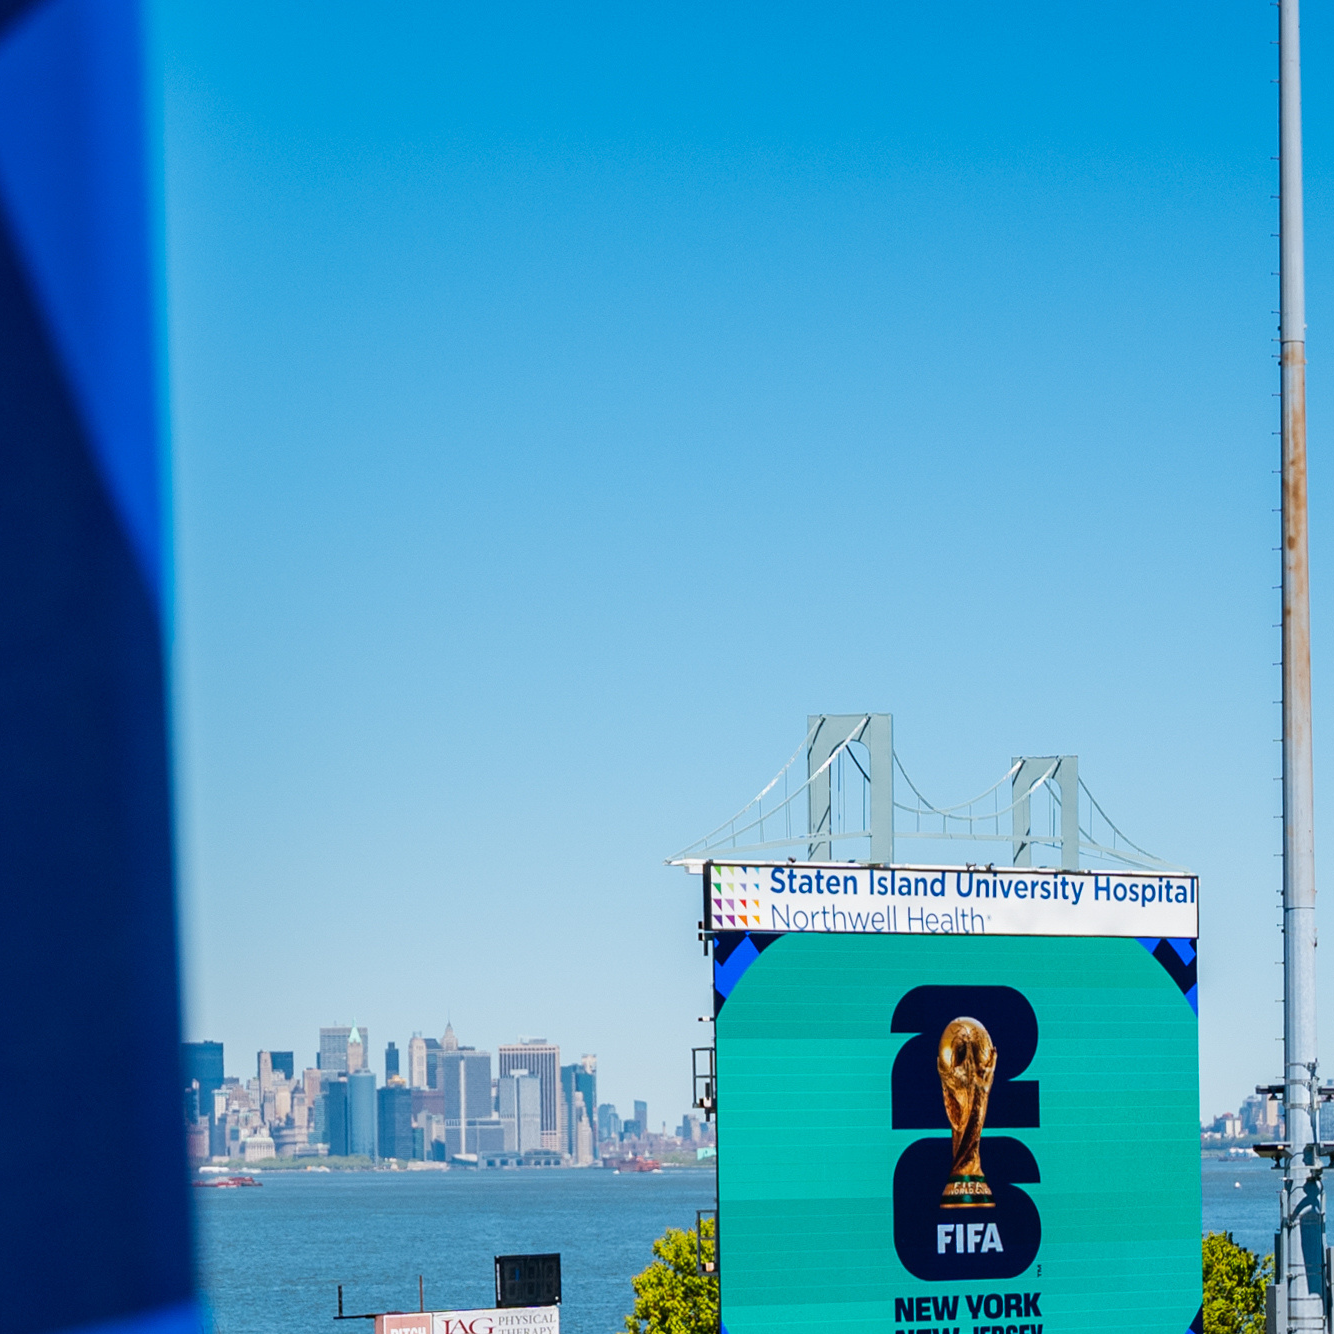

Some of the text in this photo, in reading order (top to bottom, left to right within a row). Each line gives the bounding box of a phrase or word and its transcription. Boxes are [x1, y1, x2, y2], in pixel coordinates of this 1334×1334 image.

[770, 866, 1196, 907] Staten Island University Hospital
[771, 903, 986, 933] Northwell Health
[937, 1222, 1004, 1254] FIFA
[498, 1314, 556, 1326] PHYSICAL
[894, 1292, 1042, 1323] NEW YORK
